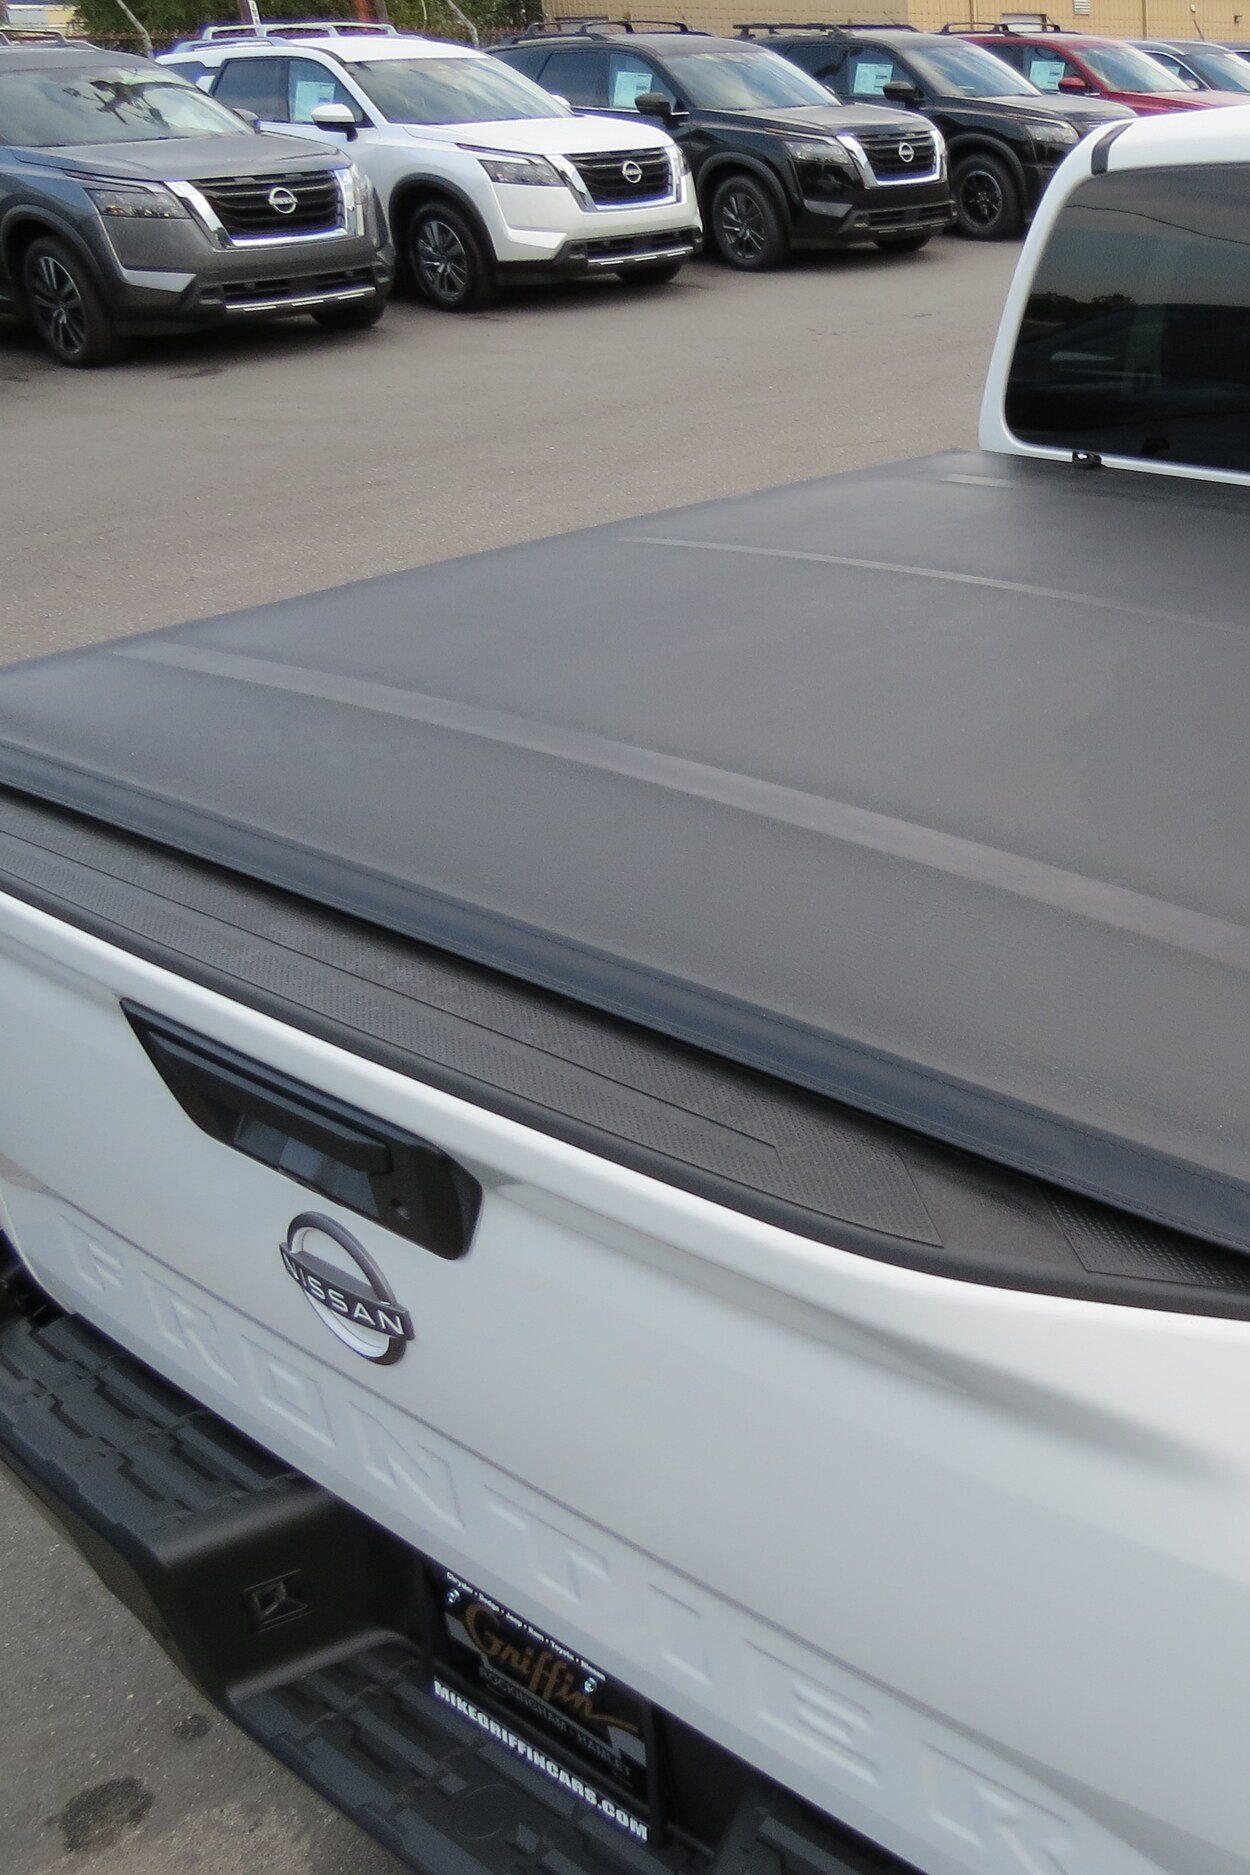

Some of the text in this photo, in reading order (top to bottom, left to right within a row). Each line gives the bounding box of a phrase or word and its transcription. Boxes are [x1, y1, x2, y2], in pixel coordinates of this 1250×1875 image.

[282, 1251, 405, 1336] NISSAN
[58, 1210, 1082, 1875] FRONTIER
[463, 1602, 640, 1735] Griffin
[479, 1666, 631, 1777] ROCKINGHAM HAMLET
[433, 1678, 650, 1842] MIKEGRIFFINCARS.COM
